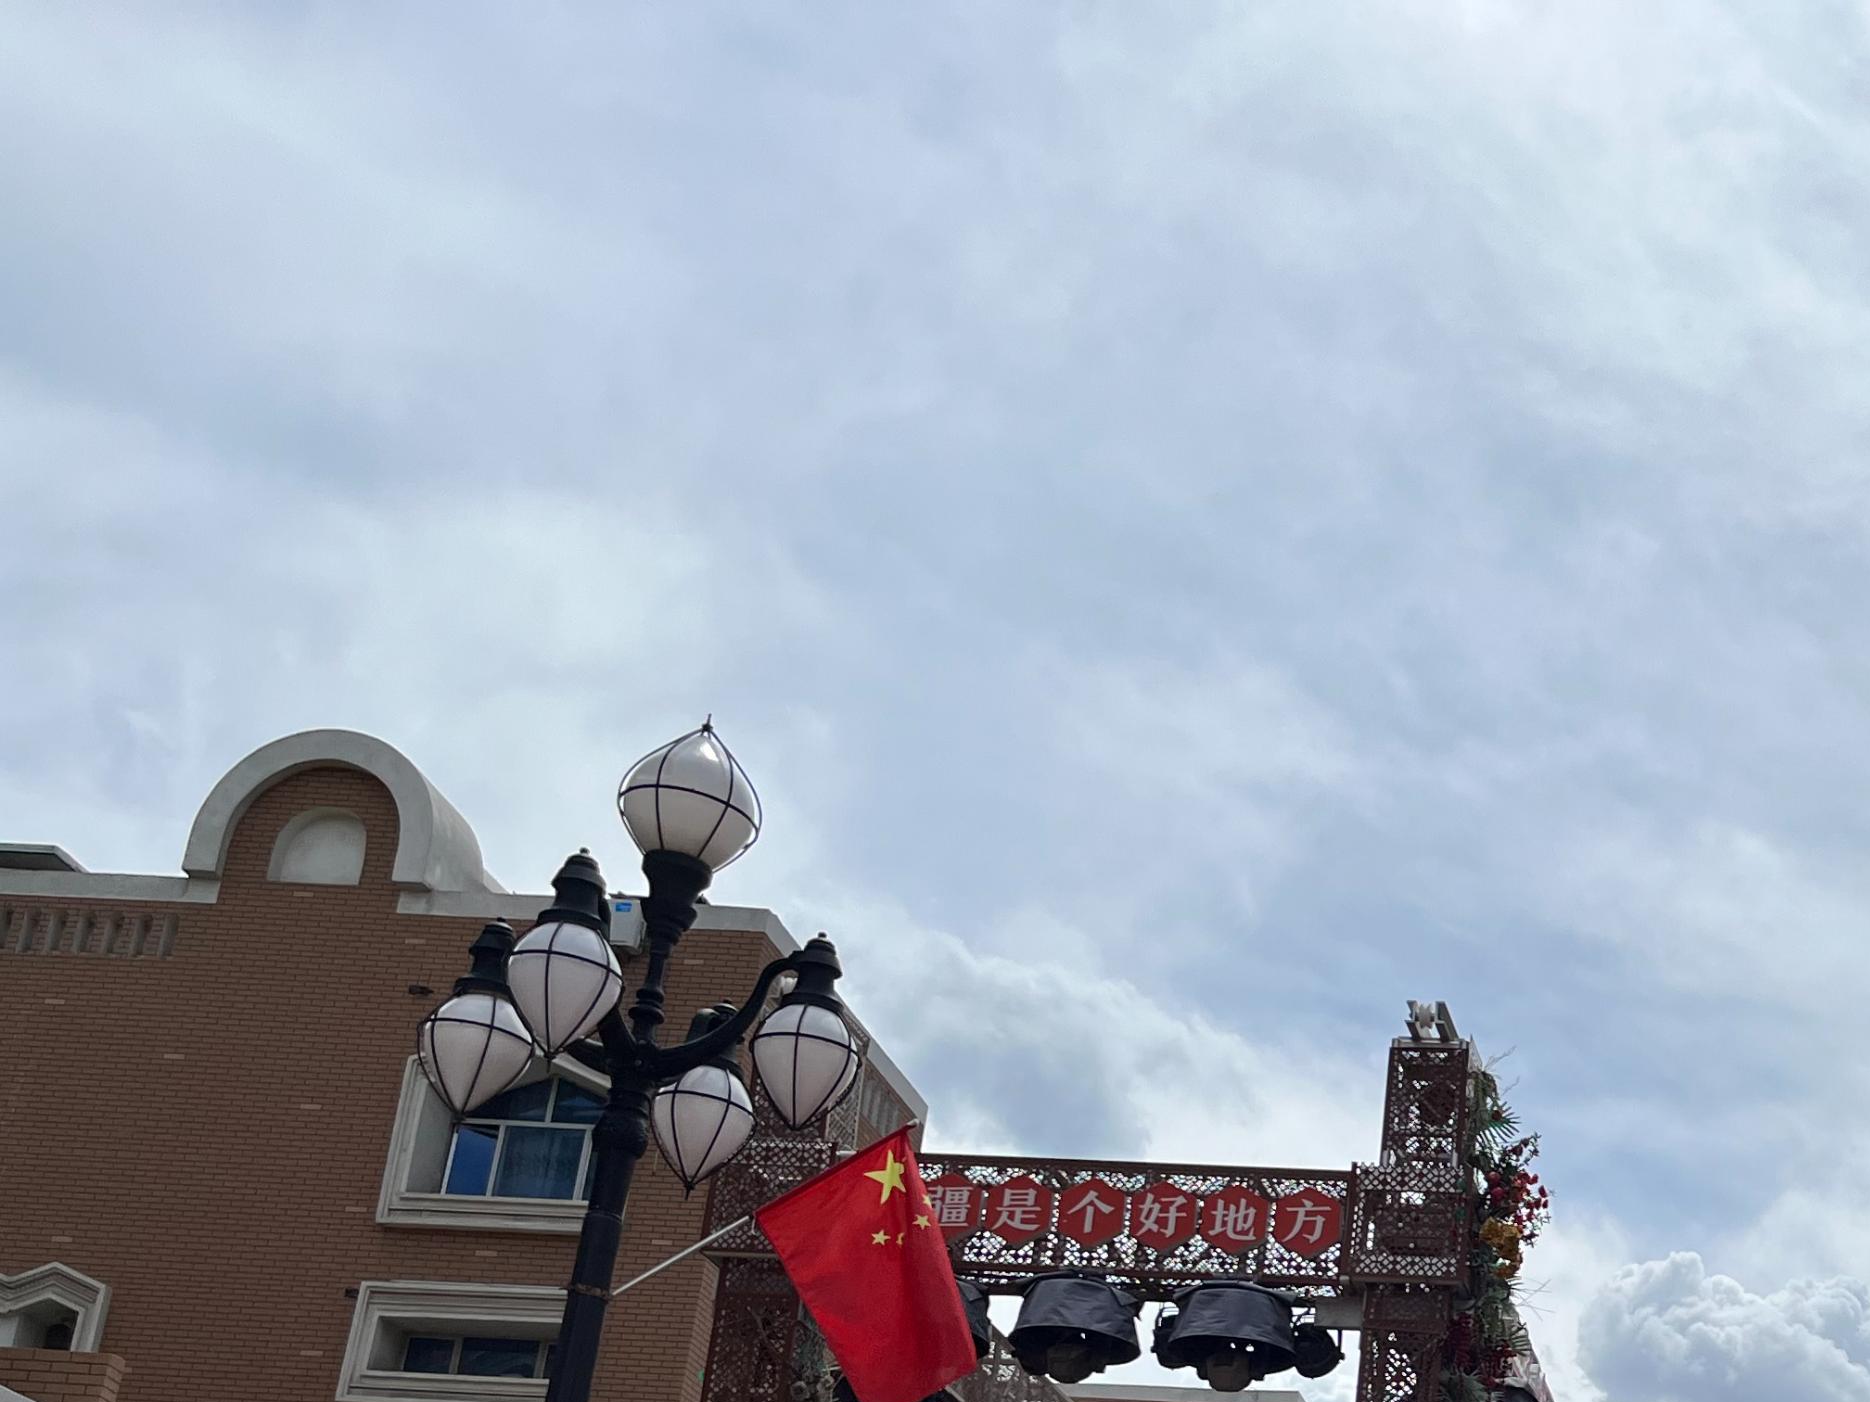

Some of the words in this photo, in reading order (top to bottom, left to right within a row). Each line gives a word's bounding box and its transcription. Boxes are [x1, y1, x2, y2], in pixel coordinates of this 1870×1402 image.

[930, 1184, 1332, 1243] 疆是个好地方
